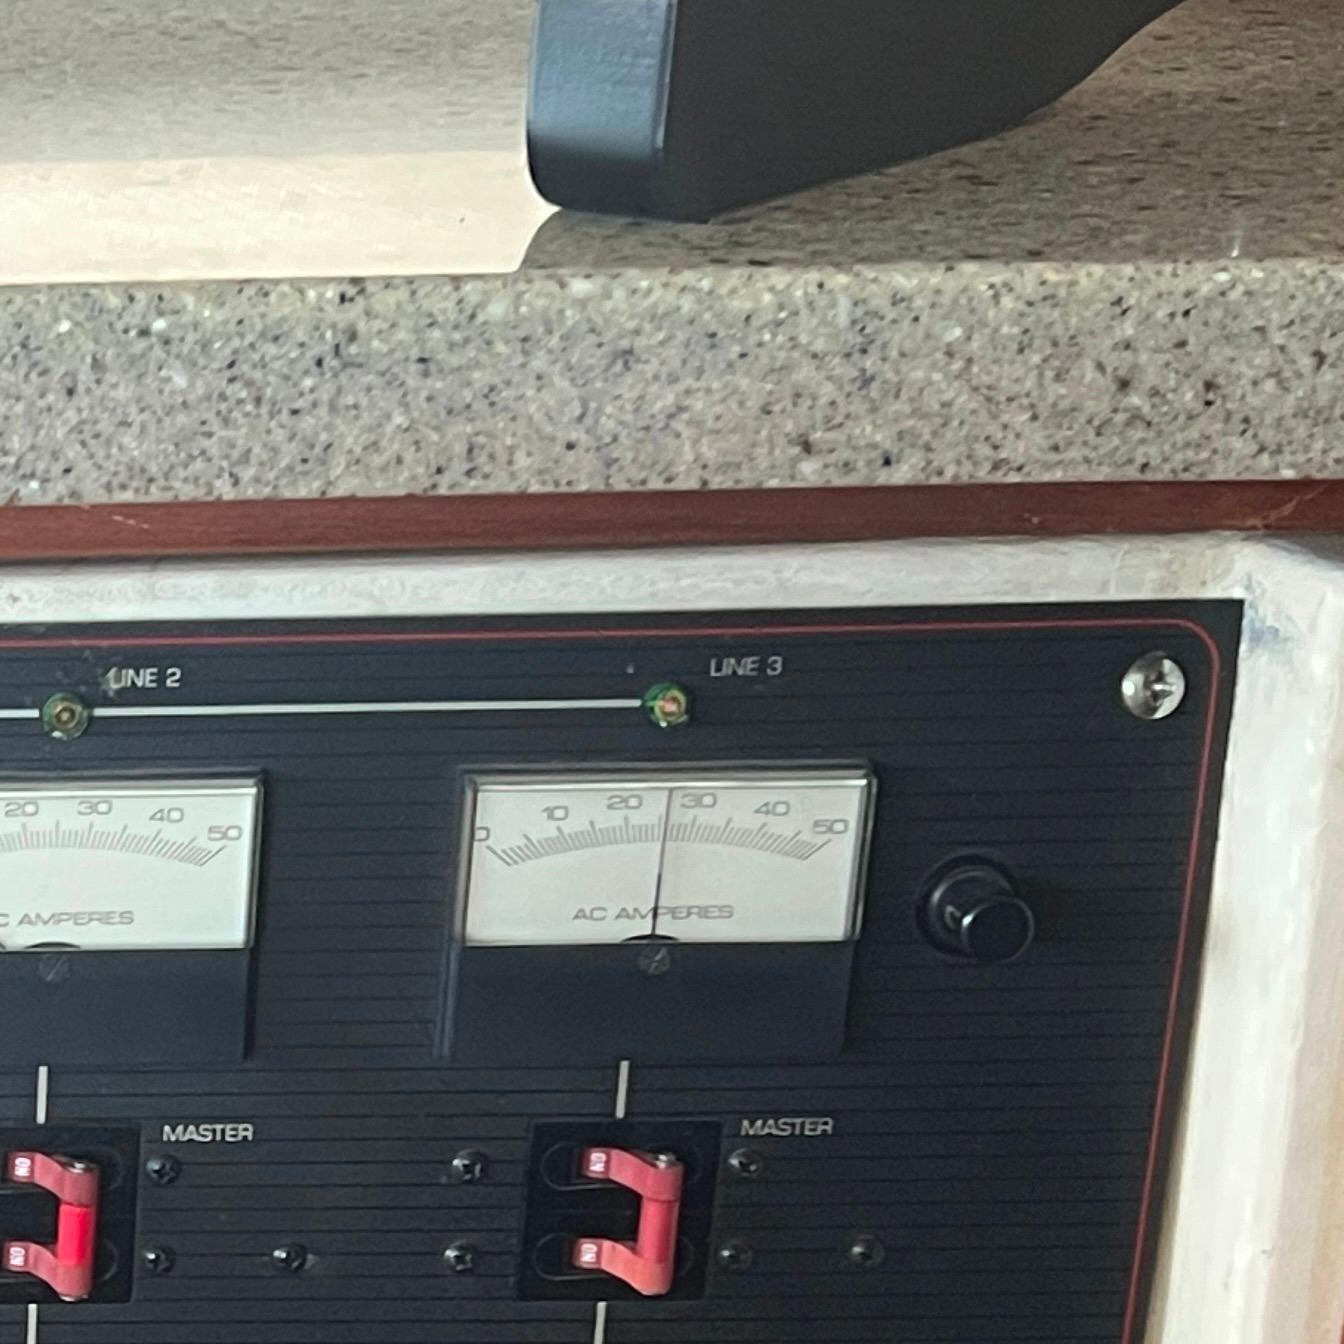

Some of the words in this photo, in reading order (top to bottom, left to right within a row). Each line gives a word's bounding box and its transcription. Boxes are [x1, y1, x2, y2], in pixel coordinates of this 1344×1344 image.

[709, 658, 760, 677] LINE
[766, 657, 783, 675] 3
[111, 668, 159, 688] LINE
[165, 668, 182, 687] 2
[4, 801, 39, 816] 20
[77, 799, 113, 815] 30
[607, 794, 643, 810] 20
[680, 793, 717, 809] 30
[754, 800, 790, 816] 40
[149, 807, 184, 822] 40
[542, 805, 569, 821] 10
[207, 825, 242, 841] 50
[812, 819, 848, 835] 50
[18, 910, 134, 926] AMPERES
[573, 906, 607, 921] AC
[615, 905, 733, 920] AMPERES
[163, 1124, 253, 1142] MASTER
[741, 1118, 833, 1136] MASTER
